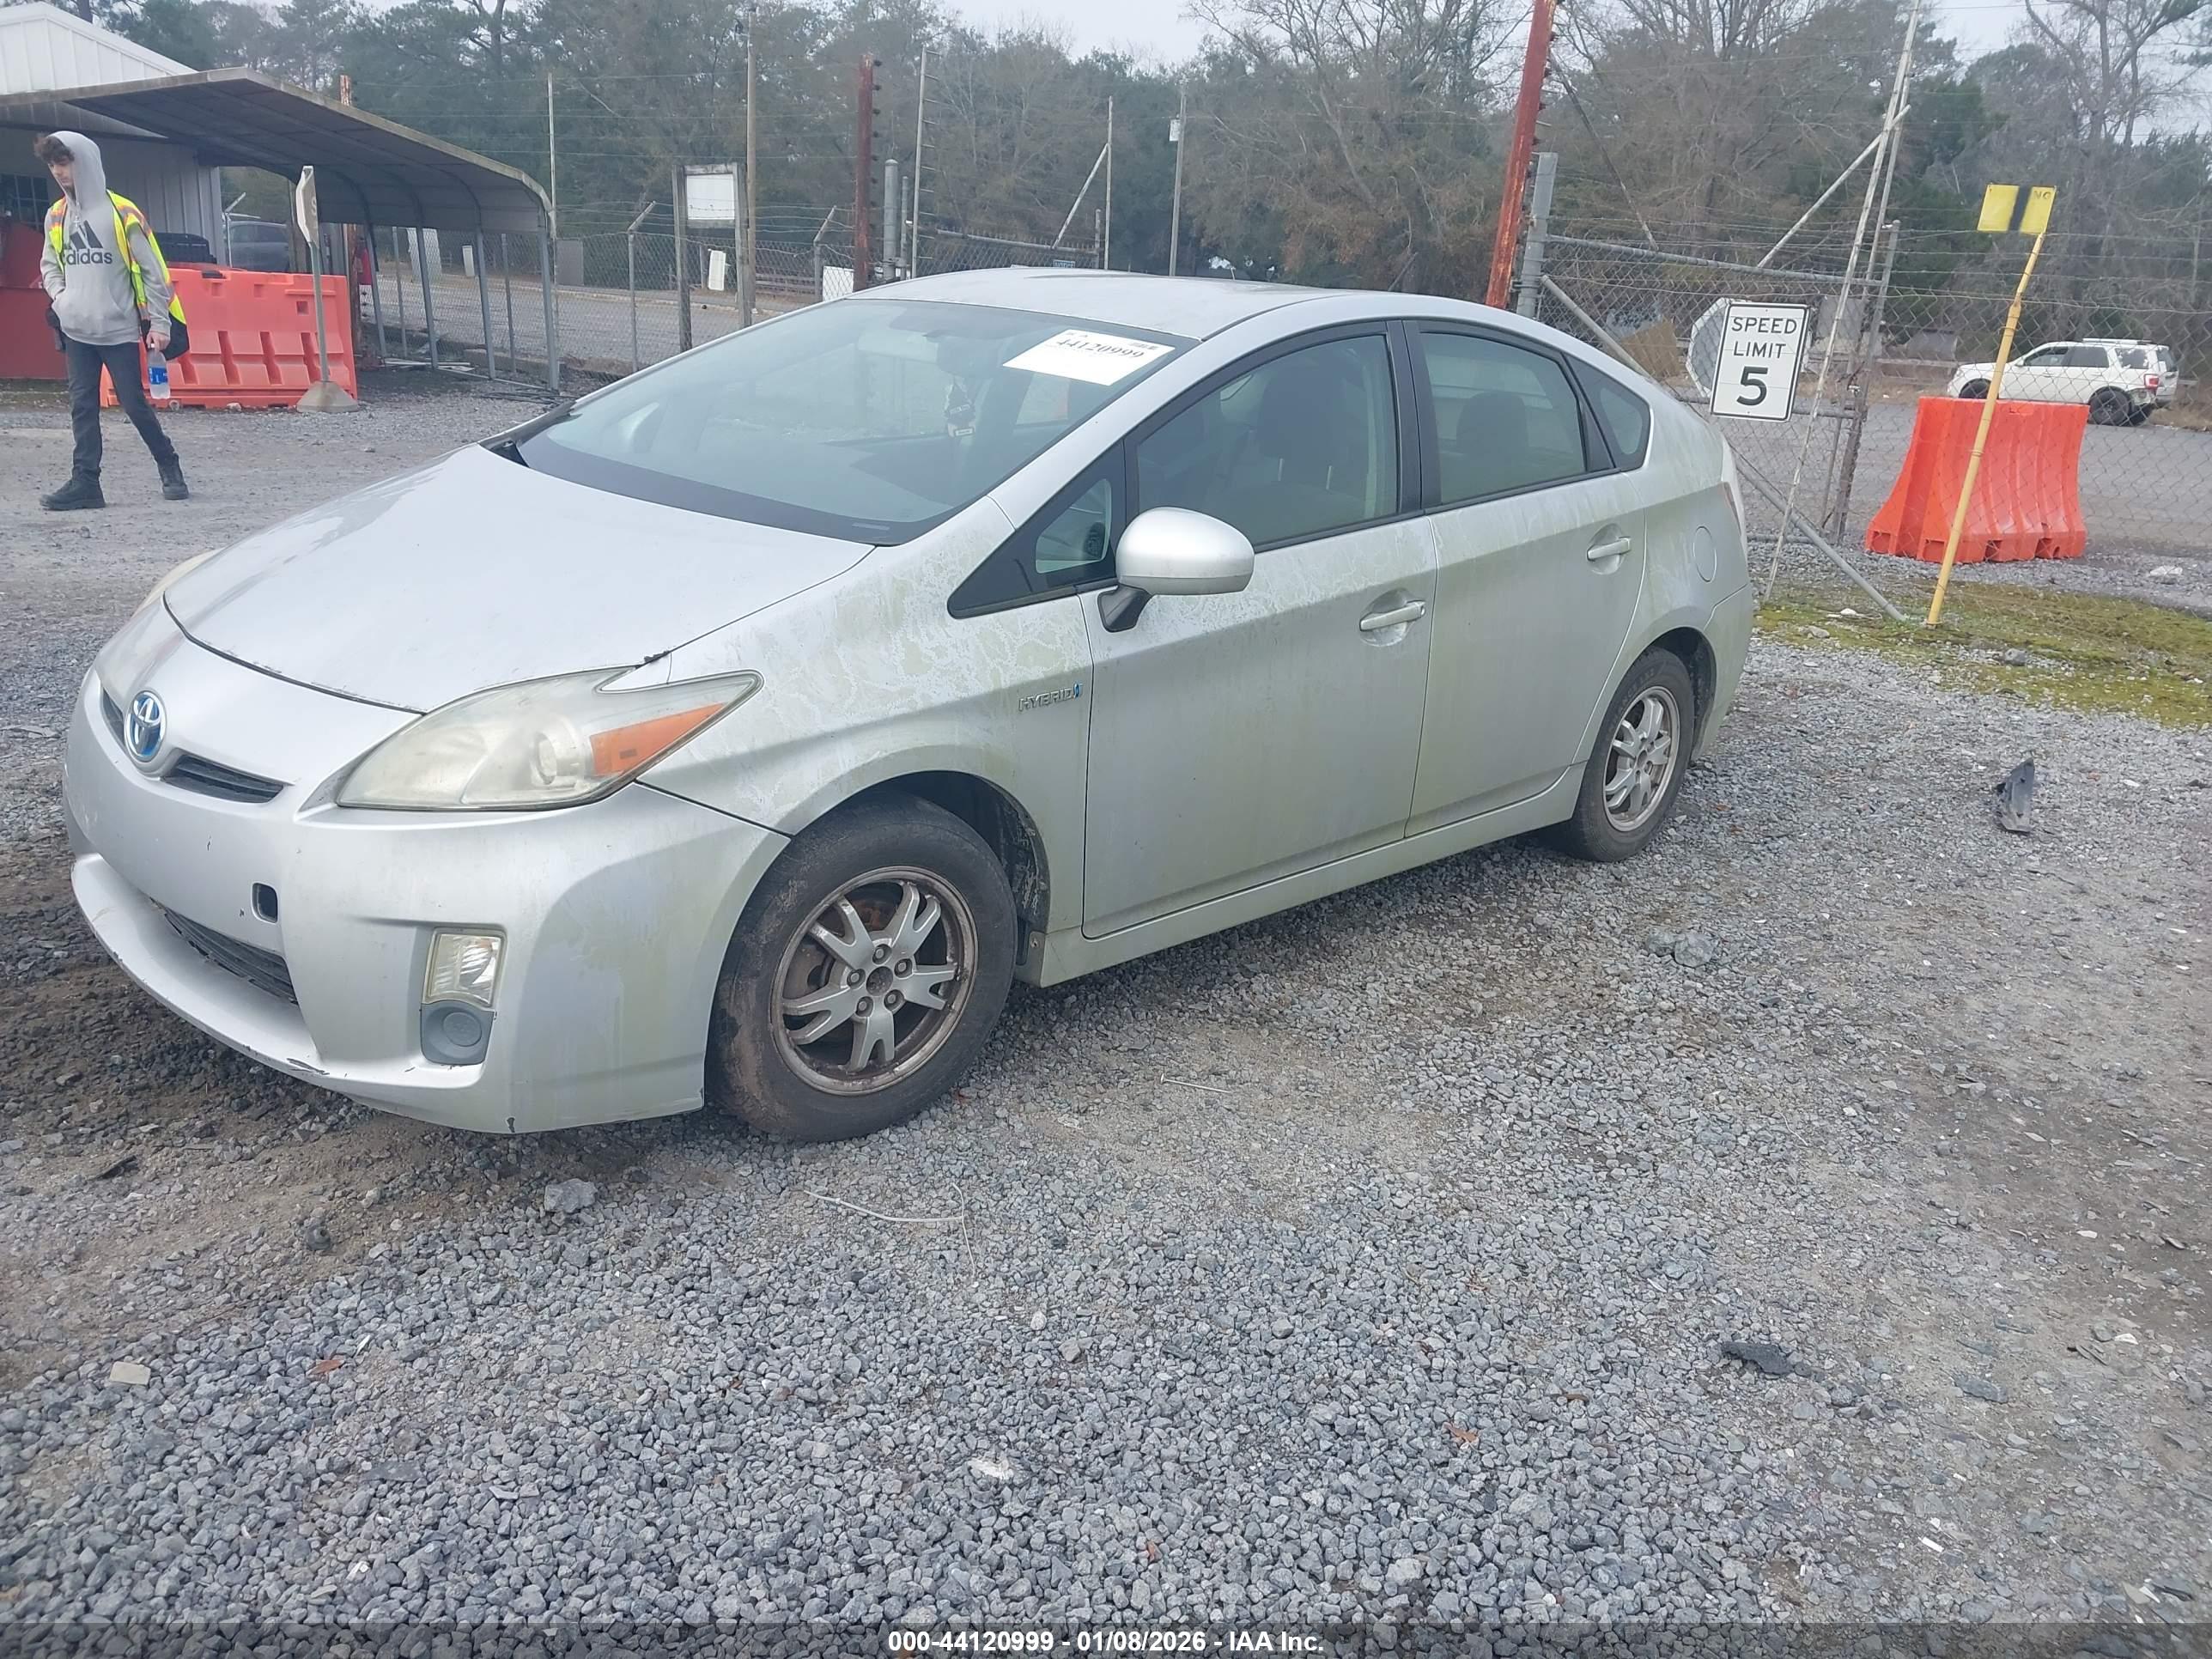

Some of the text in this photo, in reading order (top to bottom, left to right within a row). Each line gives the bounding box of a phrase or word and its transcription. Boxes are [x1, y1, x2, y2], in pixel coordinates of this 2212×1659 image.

[63, 248, 112, 265] didas
[1731, 317, 1797, 334] SPEED
[1056, 340, 1145, 357] 44120999
[1734, 341, 1786, 358] LIMIT
[1736, 366, 1768, 406] 5
[1018, 688, 1073, 712] HYBRID
